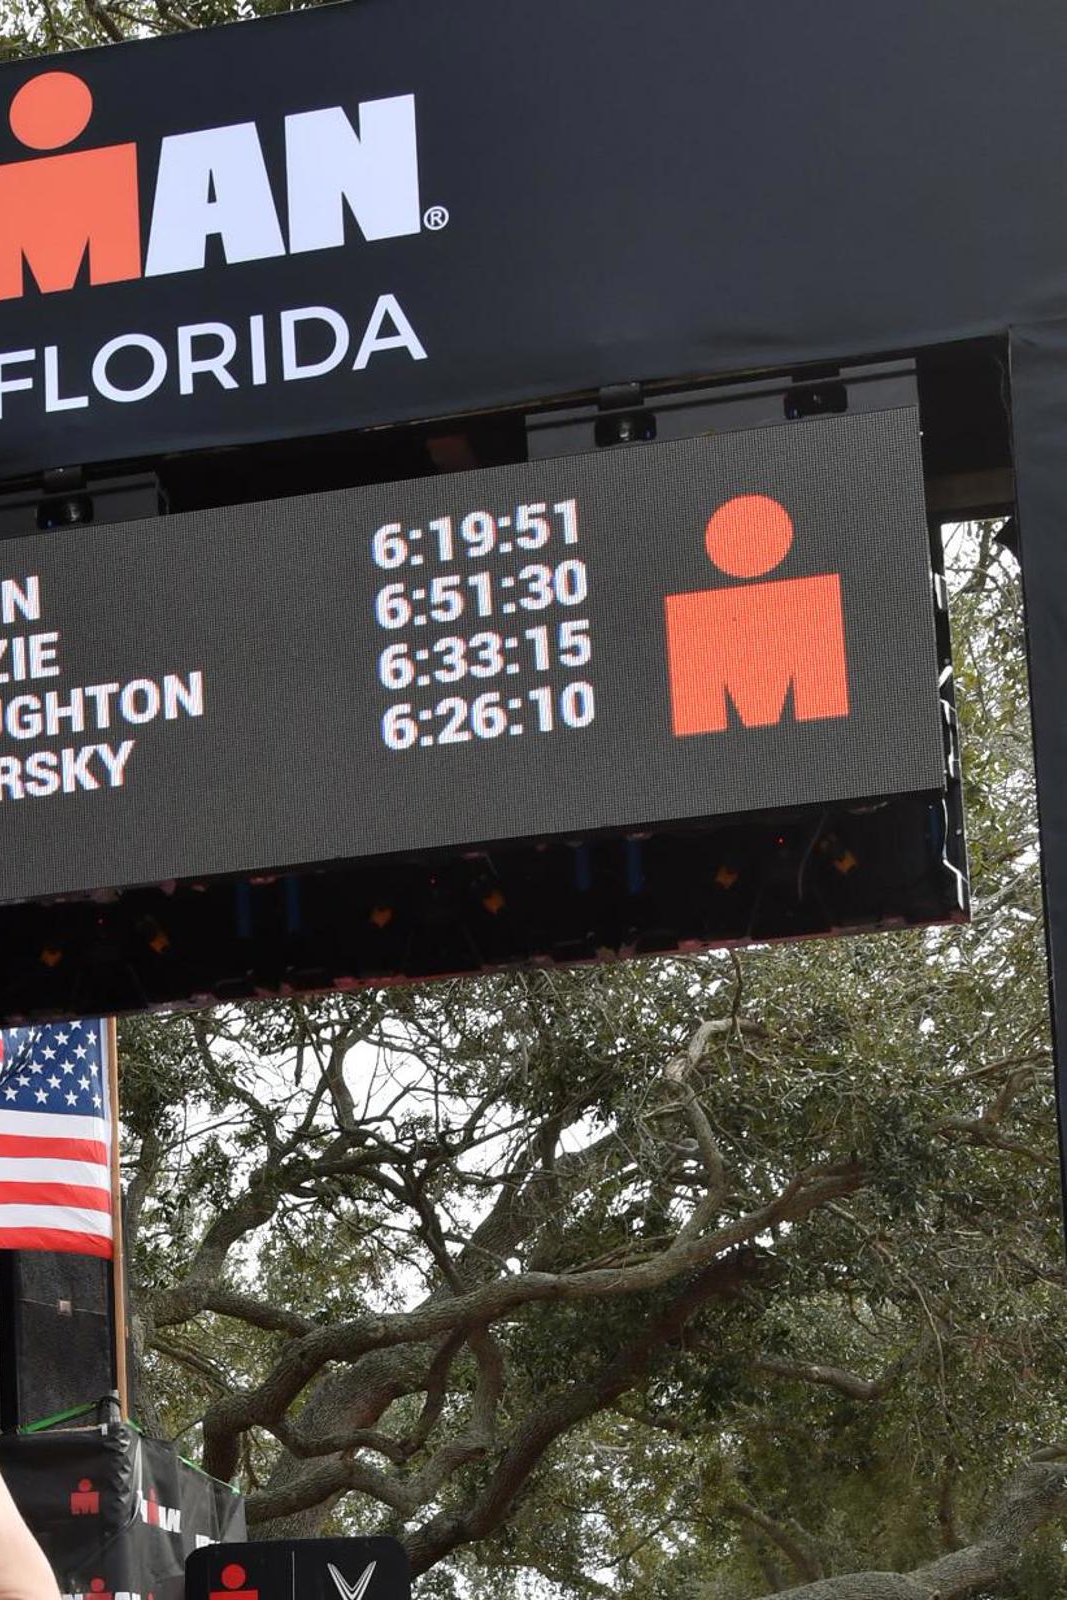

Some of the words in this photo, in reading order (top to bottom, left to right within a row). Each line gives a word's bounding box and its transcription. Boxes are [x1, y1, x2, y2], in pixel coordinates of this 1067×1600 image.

[371, 498, 580, 569] 6:19:51
[375, 559, 588, 630] 6:51:30
[378, 619, 592, 690] 6:33:15
[381, 680, 596, 750] 6:26:10
